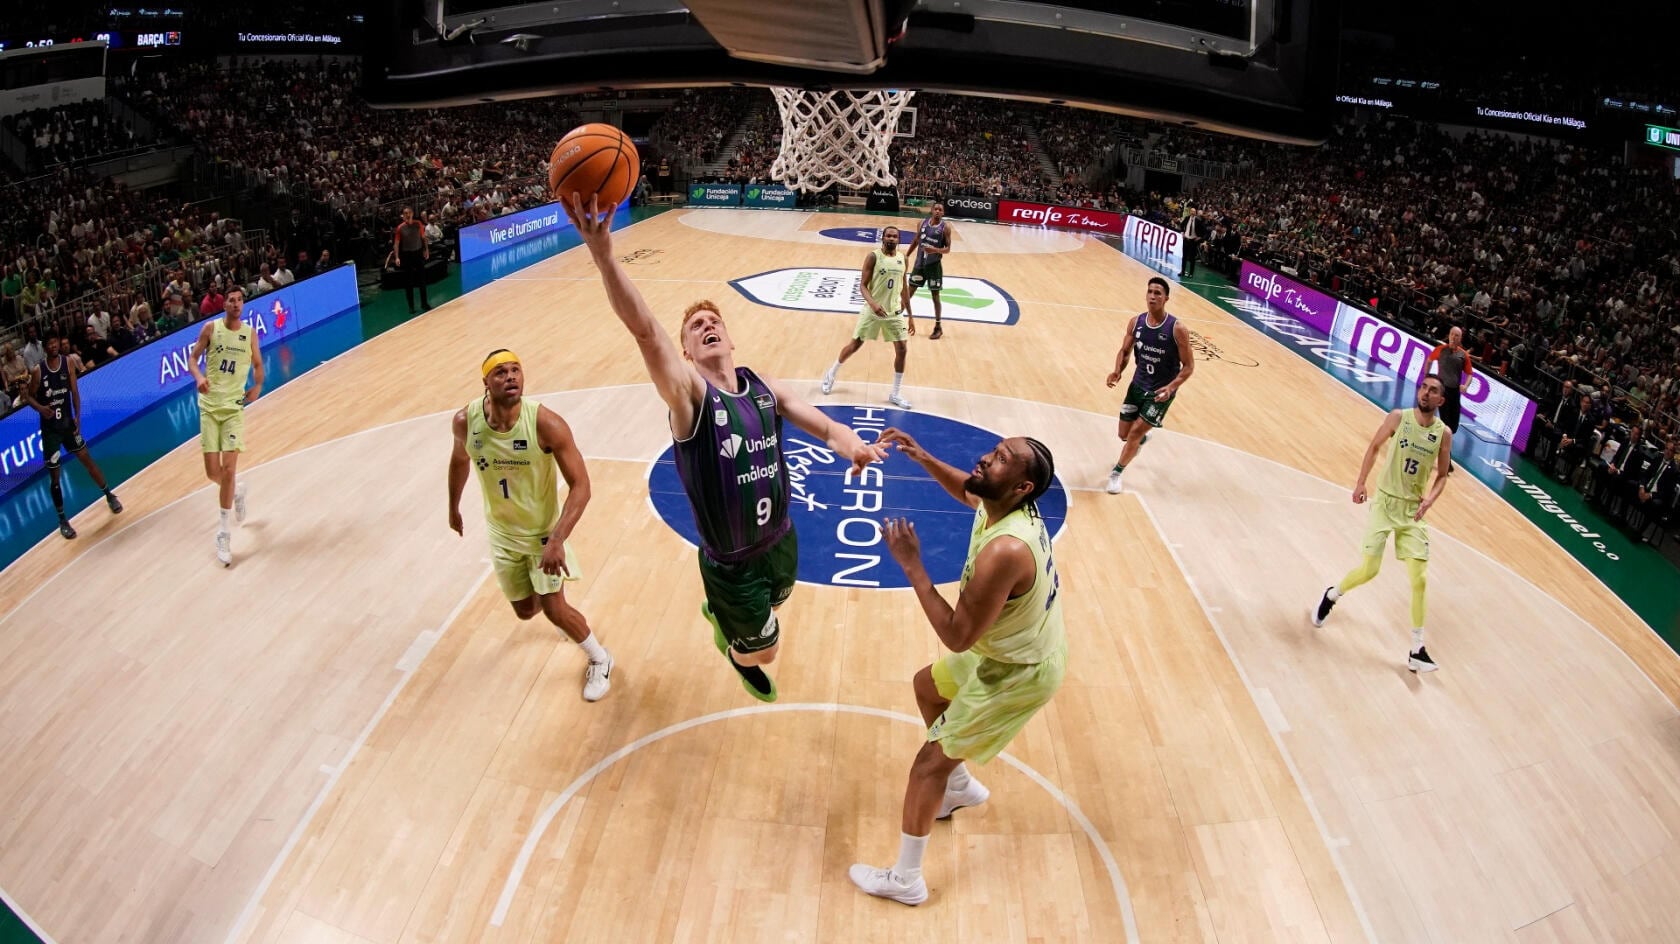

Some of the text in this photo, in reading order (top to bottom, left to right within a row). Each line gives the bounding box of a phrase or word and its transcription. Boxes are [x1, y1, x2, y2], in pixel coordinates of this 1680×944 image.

[137, 33, 164, 47] BARÇA
[238, 32, 246, 42] Tu
[247, 32, 287, 42] Concesionario
[287, 33, 305, 42] Oficial
[305, 34, 314, 42] Kia
[1341, 96, 1358, 104] Oficial
[1476, 106, 1484, 115] Tu
[1484, 107, 1523, 120] Concesionario
[1523, 111, 1542, 122] Oficial
[1542, 113, 1553, 124] Kia
[1553, 116, 1562, 125] en
[705, 193, 730, 201] Unicaja
[706, 187, 739, 196] Fundación
[760, 194, 786, 202] Unicaja
[761, 188, 794, 197] Fundación
[947, 198, 992, 210] endesa
[1012, 206, 1109, 228] renfe Tu tren
[489, 210, 558, 245] Vive el turismo rural
[887, 278, 895, 290] 0
[1248, 271, 1318, 316] renfe Tu tren
[219, 359, 236, 375] 44
[1145, 363, 1155, 375] 0
[1349, 315, 1491, 422] rene
[55, 407, 62, 420] 6
[1403, 457, 1420, 476] 13
[498, 478, 510, 499] 1
[756, 497, 772, 526] 9
